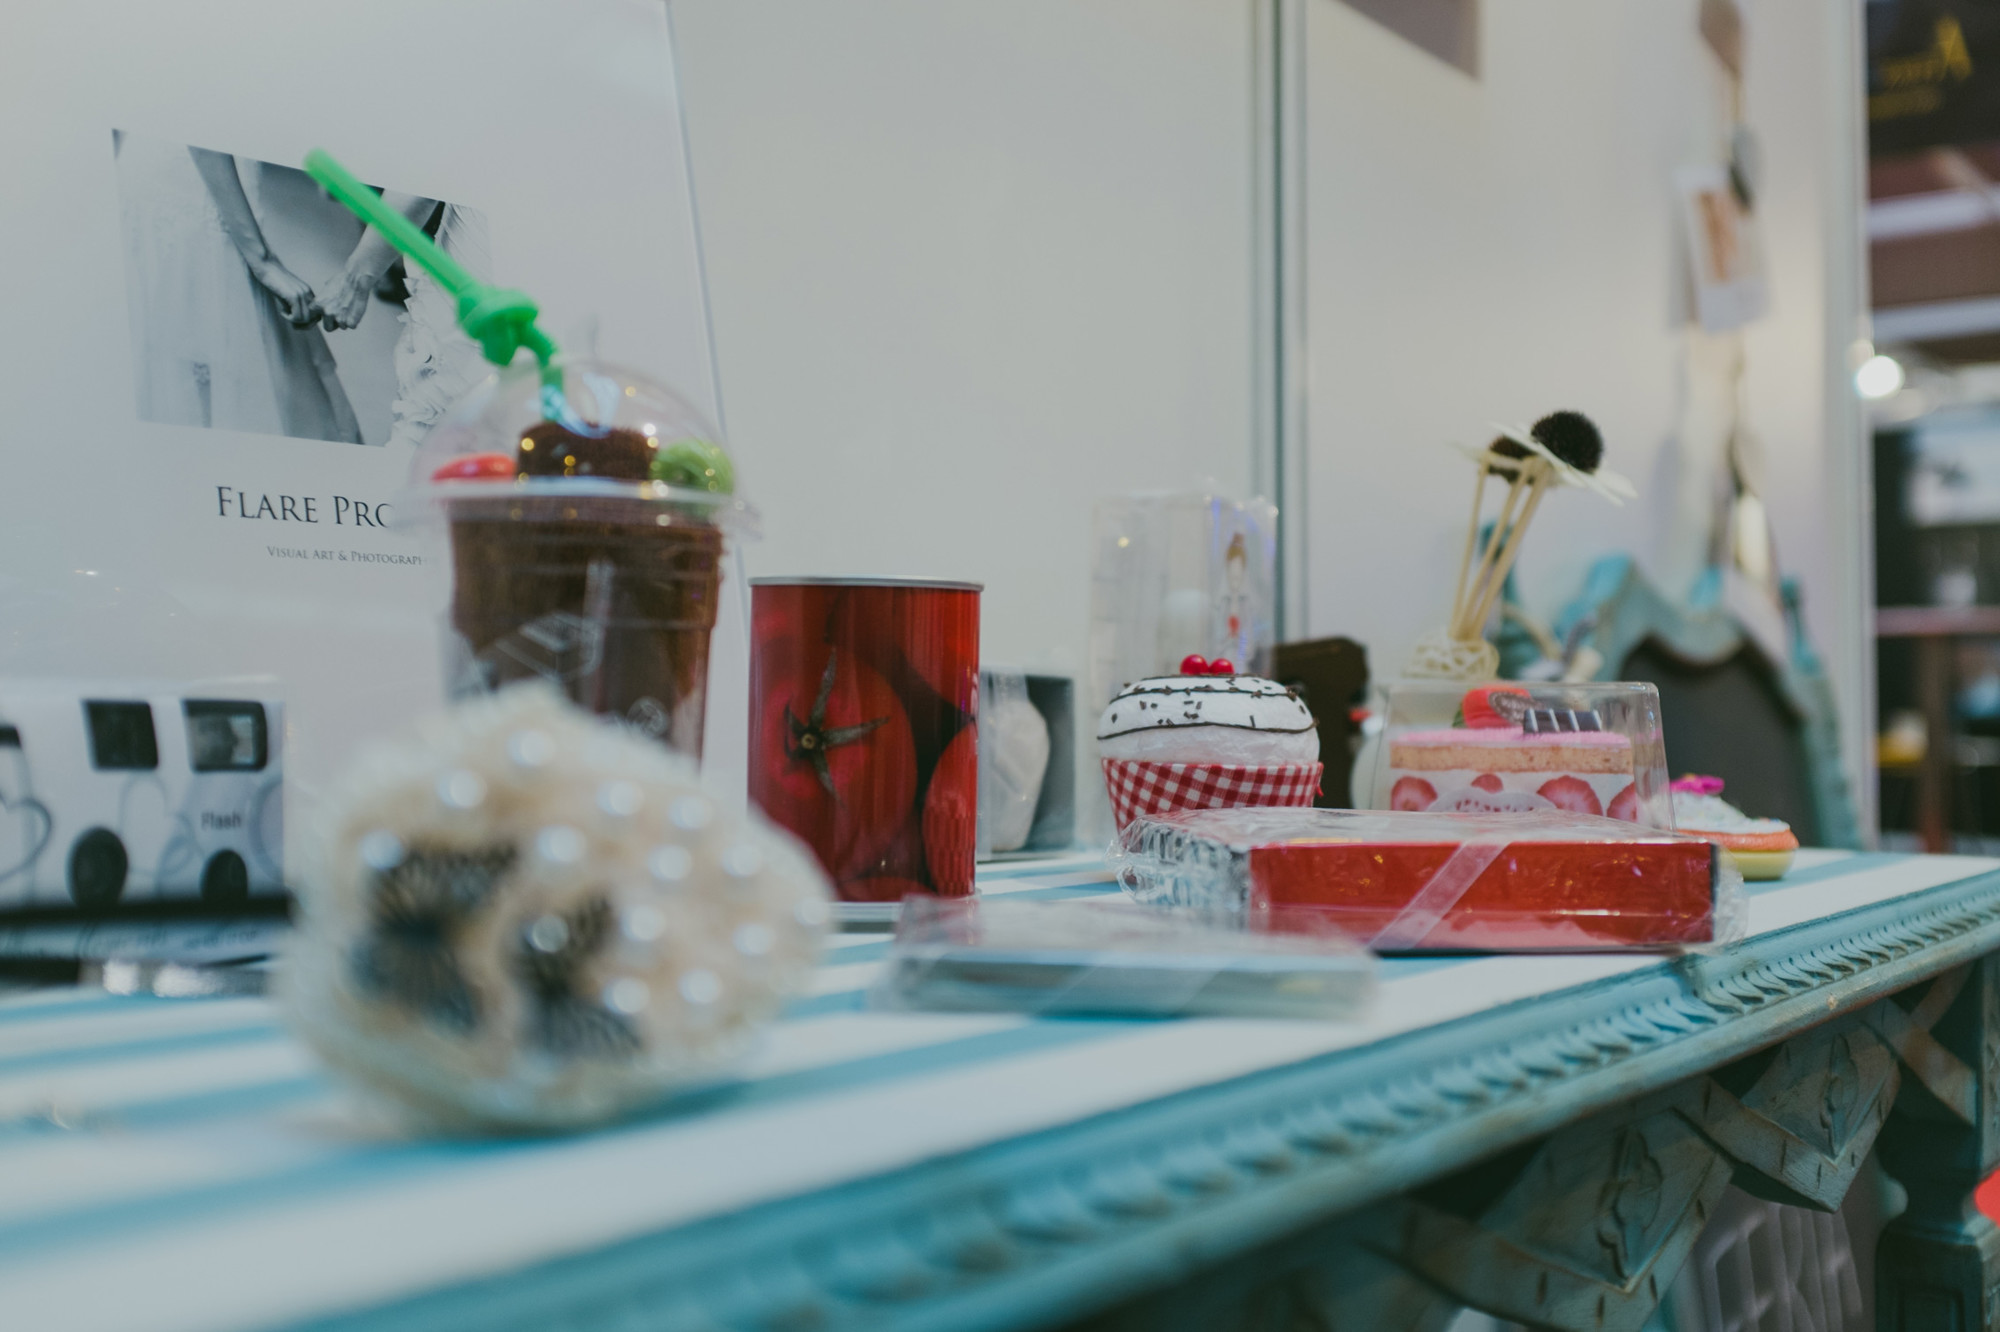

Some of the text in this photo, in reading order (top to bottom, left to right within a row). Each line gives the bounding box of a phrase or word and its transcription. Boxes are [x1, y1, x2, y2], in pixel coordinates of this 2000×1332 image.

[216, 485, 319, 523] FLARE
[266, 545, 308, 561] VISUAL
[312, 549, 335, 562] ART
[338, 550, 347, 562] &
[201, 810, 242, 831] Flash
